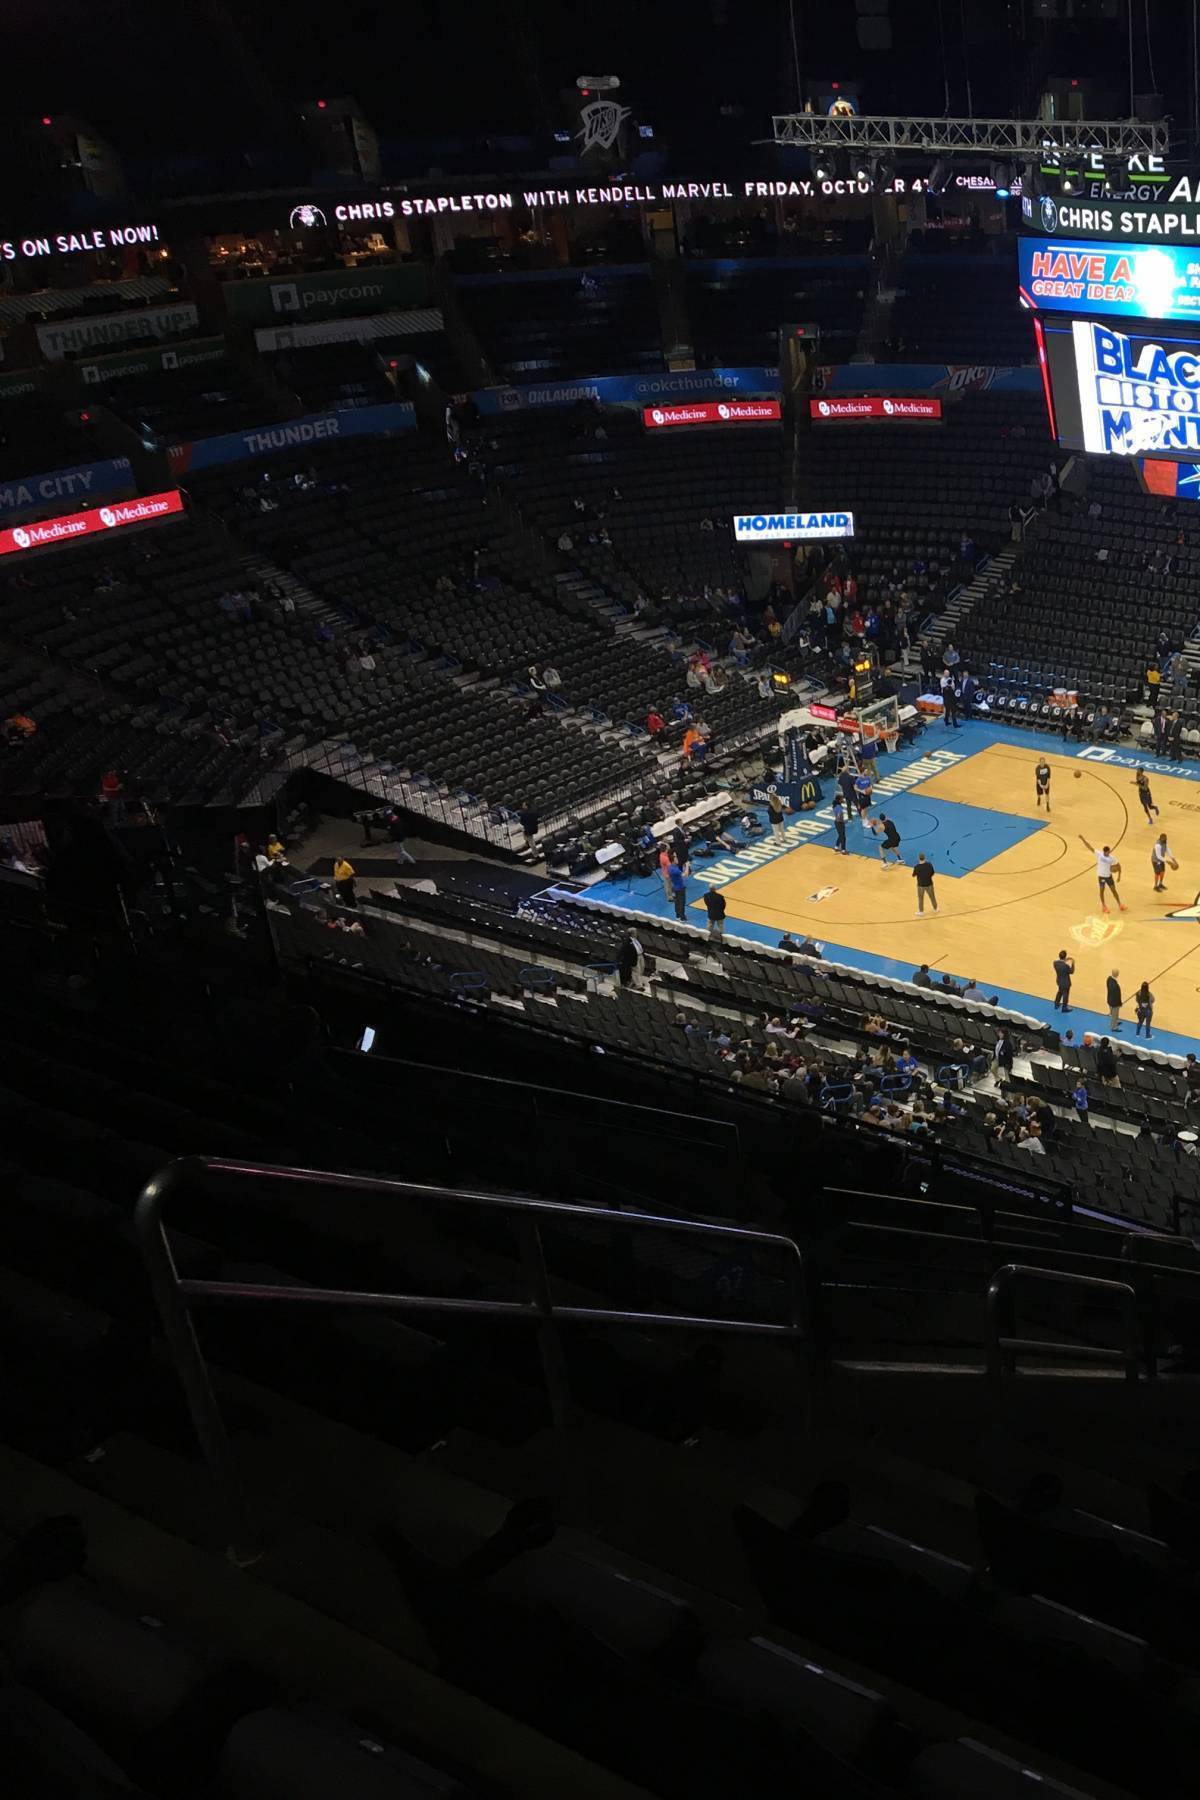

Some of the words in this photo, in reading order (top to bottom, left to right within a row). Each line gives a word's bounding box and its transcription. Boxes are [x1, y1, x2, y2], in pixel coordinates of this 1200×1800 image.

[335, 202, 394, 221] CHRIS
[402, 194, 513, 216] STAPLETON
[523, 190, 570, 207] WITH
[576, 186, 655, 204] KENDELL
[662, 183, 733, 199] MARVEL
[745, 181, 815, 197] FRIDAY,
[1090, 182, 1164, 201] ENRGY
[1059, 206, 1113, 231] CHRIS
[0, 243, 16, 260] S
[22, 238, 51, 256] ON
[57, 231, 106, 253] SALE
[110, 225, 159, 246] NOW!
[1032, 252, 1105, 281] HAVE
[1110, 257, 1131, 282] A
[302, 283, 381, 307] paycom
[1032, 281, 1083, 297] GREAT
[1087, 283, 1135, 300] IDEA?
[46, 318, 152, 350] THUNDER
[177, 349, 225, 368] paycom
[101, 361, 149, 380] paycom
[764, 368, 780, 377] 112
[637, 375, 740, 393] @okcthunder
[528, 387, 599, 404] OKLAHOMA
[665, 409, 707, 421] Medicine
[730, 407, 772, 417] Medicine
[830, 401, 872, 413] Medicine
[894, 402, 934, 413] Medicine
[244, 418, 341, 453] THUNDER
[113, 458, 130, 471] 110
[39, 470, 93, 498] CITY
[116, 501, 169, 522] Medicine
[31, 520, 87, 541] Medicine
[738, 514, 849, 531] HOMELAND
[1104, 754, 1193, 777] paycom
[753, 788, 790, 807] SPALNG
